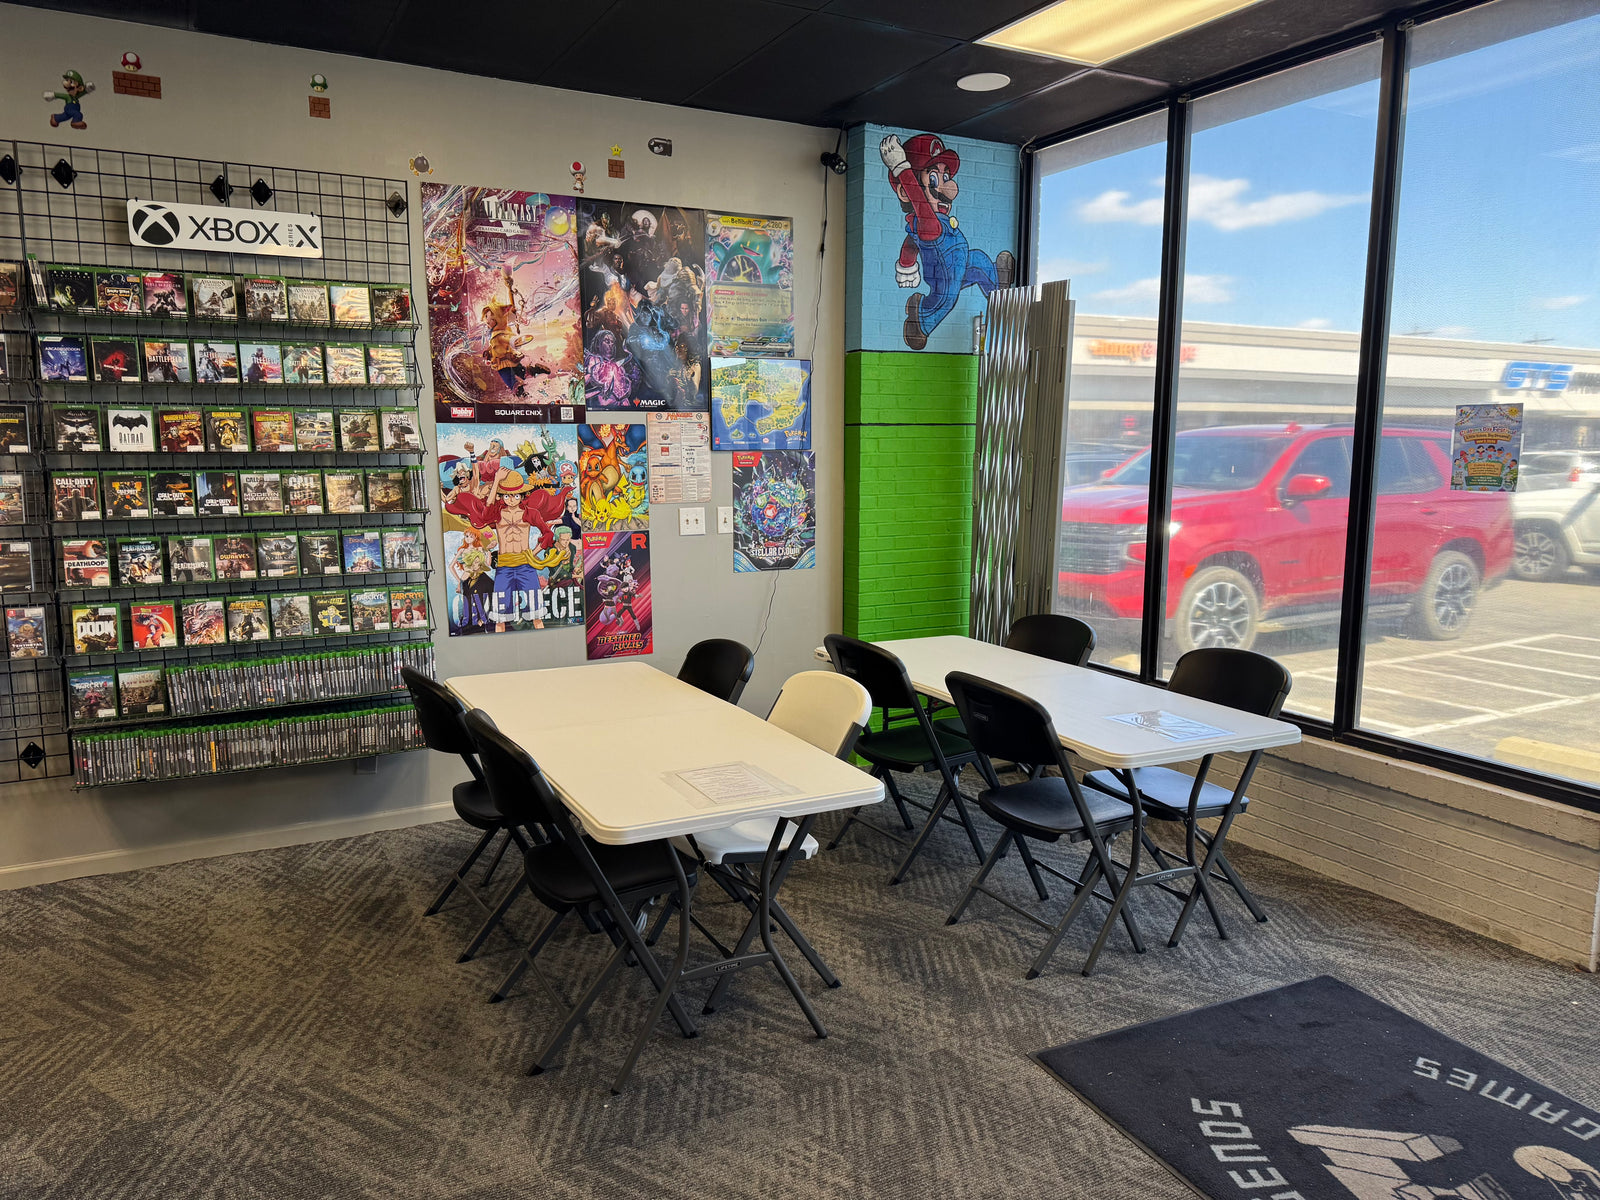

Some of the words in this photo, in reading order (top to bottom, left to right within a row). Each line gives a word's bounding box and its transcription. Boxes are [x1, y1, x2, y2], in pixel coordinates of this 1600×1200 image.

[188, 215, 281, 246] XBOX
[294, 224, 319, 249] X
[640, 399, 666, 407] MAGIC
[56, 478, 72, 486] CALL
[631, 533, 647, 550] R
[452, 591, 506, 628] ONE
[513, 586, 583, 623] PIECE
[76, 620, 115, 641] DOOM
[597, 633, 642, 646] DESTINED
[613, 641, 644, 652] RIVALS
[1412, 1056, 1600, 1141] GAMES
